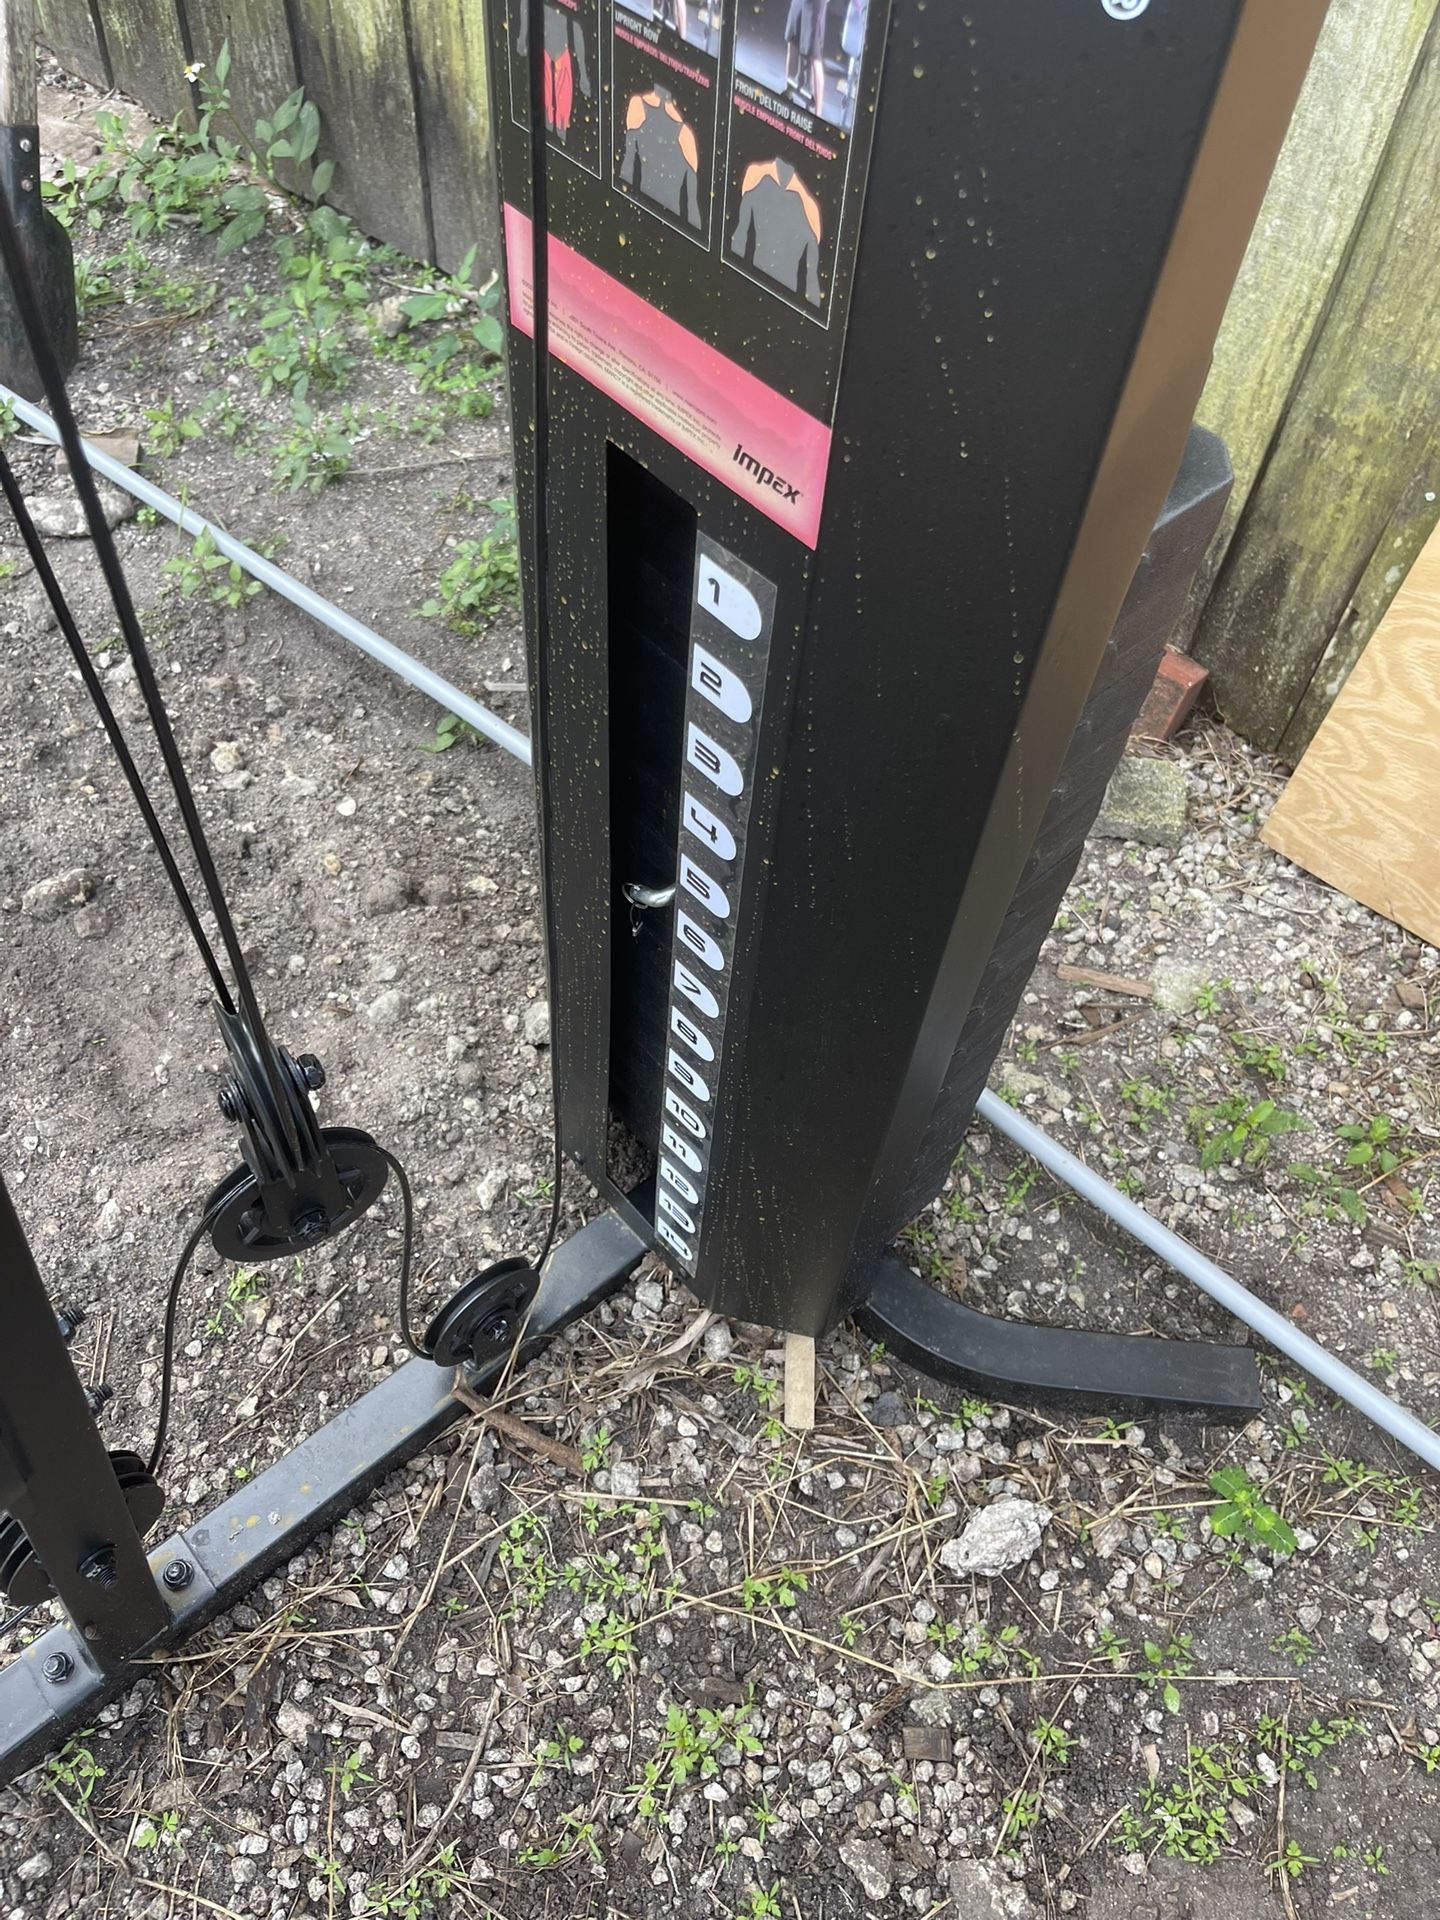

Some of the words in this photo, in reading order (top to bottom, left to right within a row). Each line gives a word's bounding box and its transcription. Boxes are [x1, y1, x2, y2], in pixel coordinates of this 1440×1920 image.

[614, 10, 642, 34] UPRIGHT
[643, 26, 660, 44] ROW
[735, 78, 758, 101] FRONT
[758, 93, 790, 120] DELTOID
[790, 110, 814, 134] RAISE
[707, 577, 721, 606] 1
[699, 661, 722, 698] 2
[694, 738, 721, 774] 3
[690, 806, 718, 844] 4
[686, 867, 711, 900] 5
[683, 923, 707, 953] 6
[680, 971, 701, 995] 7
[676, 1018, 698, 1045] 8
[674, 1060, 694, 1086] 9
[671, 1099, 699, 1132] 10
[668, 1133, 687, 1159] 11
[666, 1167, 689, 1195] 12
[664, 1197, 689, 1227] 13
[662, 1226, 689, 1256] 14
